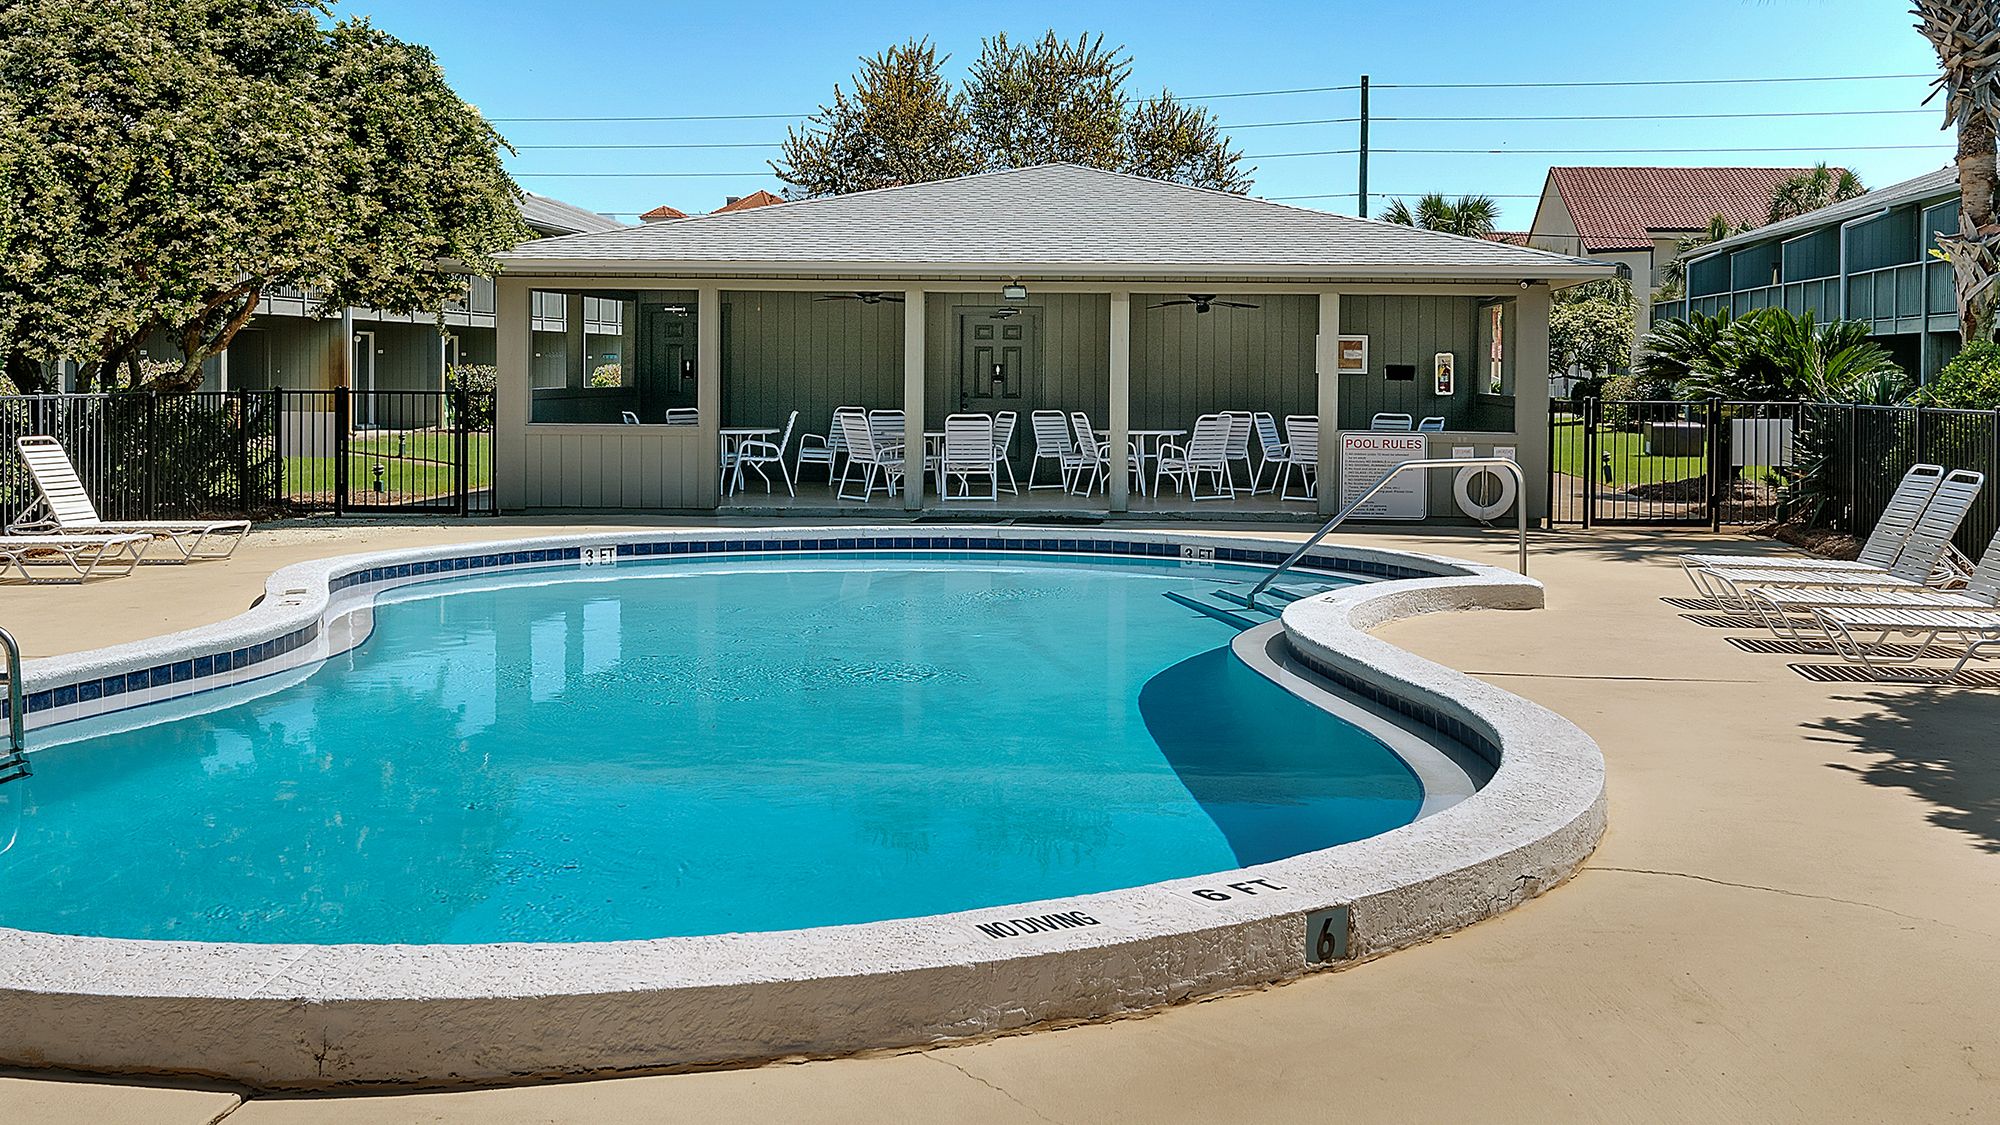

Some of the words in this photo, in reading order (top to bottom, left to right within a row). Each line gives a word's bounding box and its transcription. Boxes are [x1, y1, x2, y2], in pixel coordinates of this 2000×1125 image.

[1345, 439, 1379, 449] POOL
[1382, 439, 1422, 449] RULES
[585, 548, 594, 561] 3
[1192, 889, 1232, 901] 6
[975, 921, 1019, 939] NO
[1008, 911, 1101, 934] DIVING
[1316, 917, 1336, 962] 6
